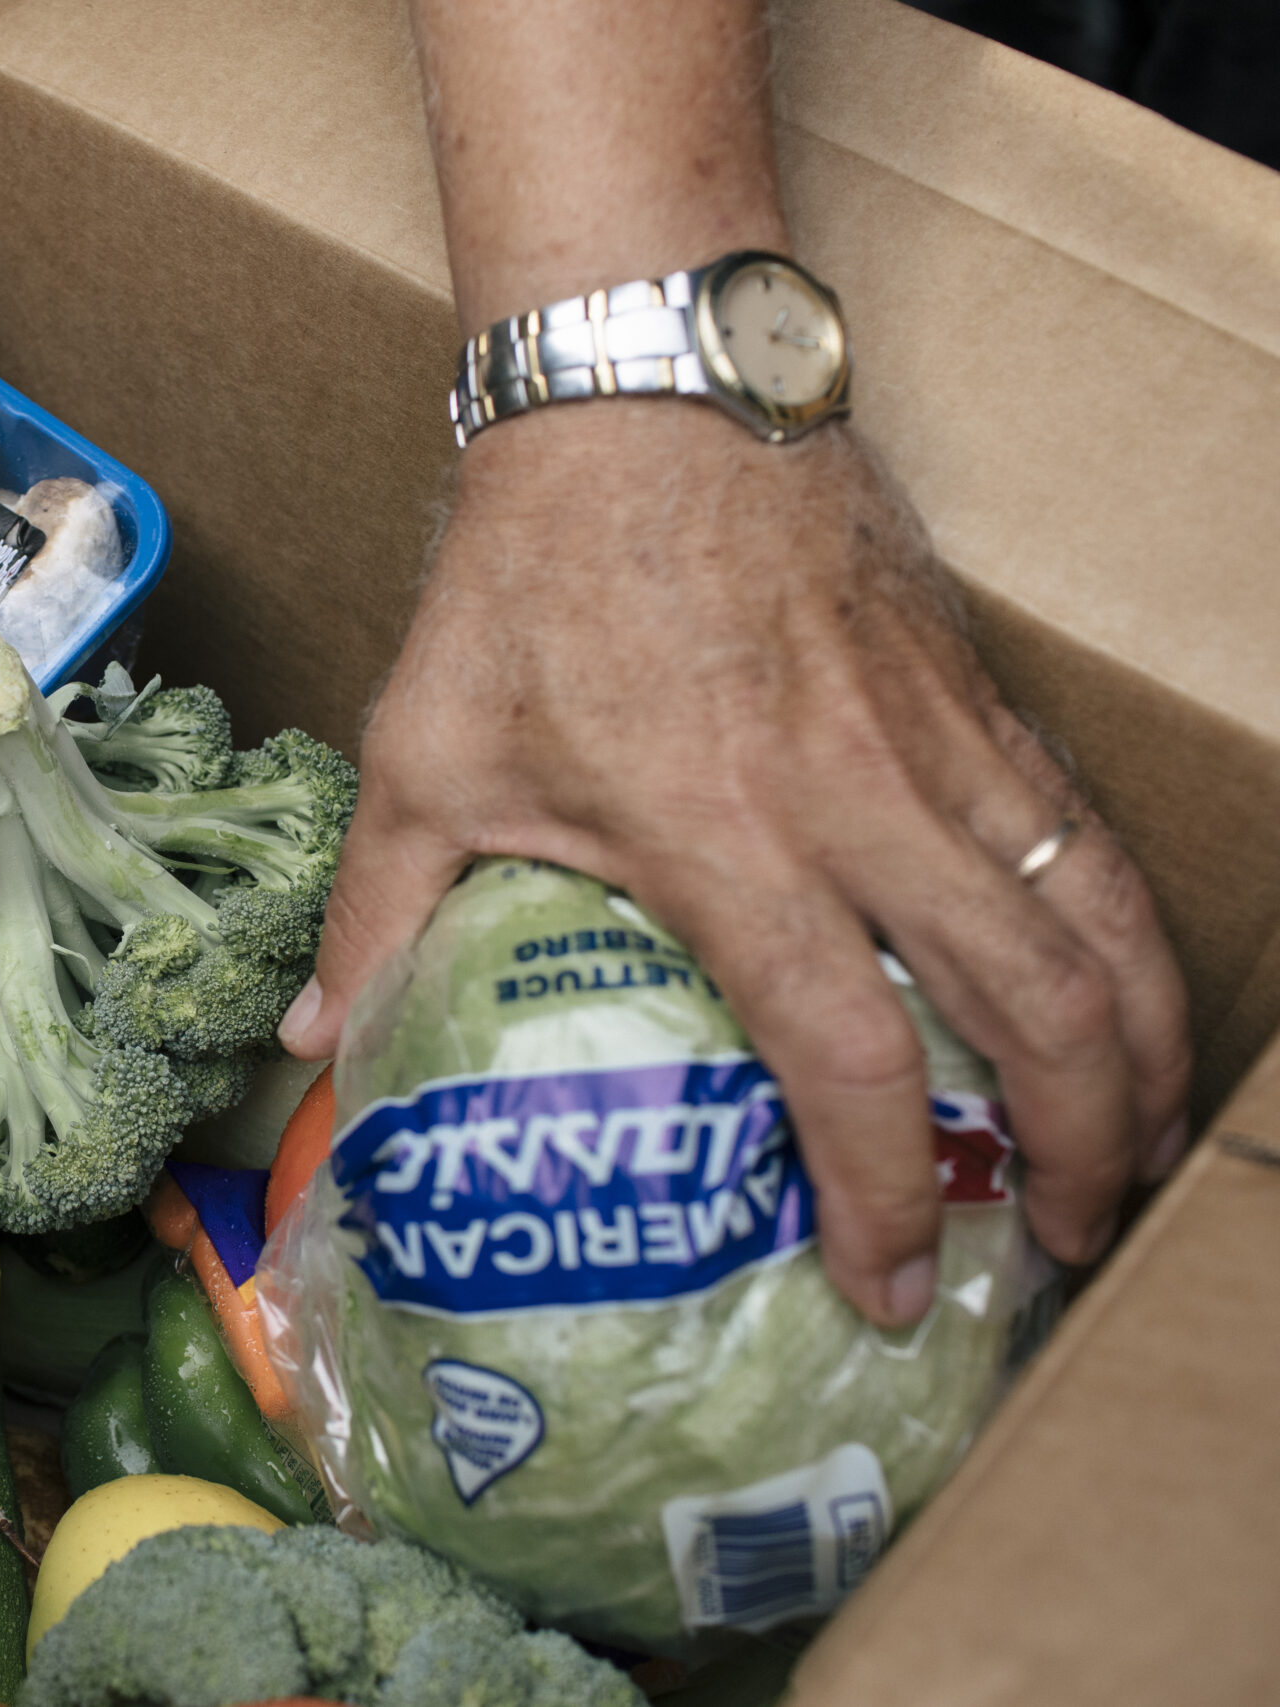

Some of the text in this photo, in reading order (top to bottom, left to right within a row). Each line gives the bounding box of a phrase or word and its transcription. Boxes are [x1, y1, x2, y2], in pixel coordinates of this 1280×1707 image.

[514, 928, 688, 963] EBERG
[497, 962, 691, 1004] LETTUCE
[377, 1154, 786, 1279] AMERICAN
